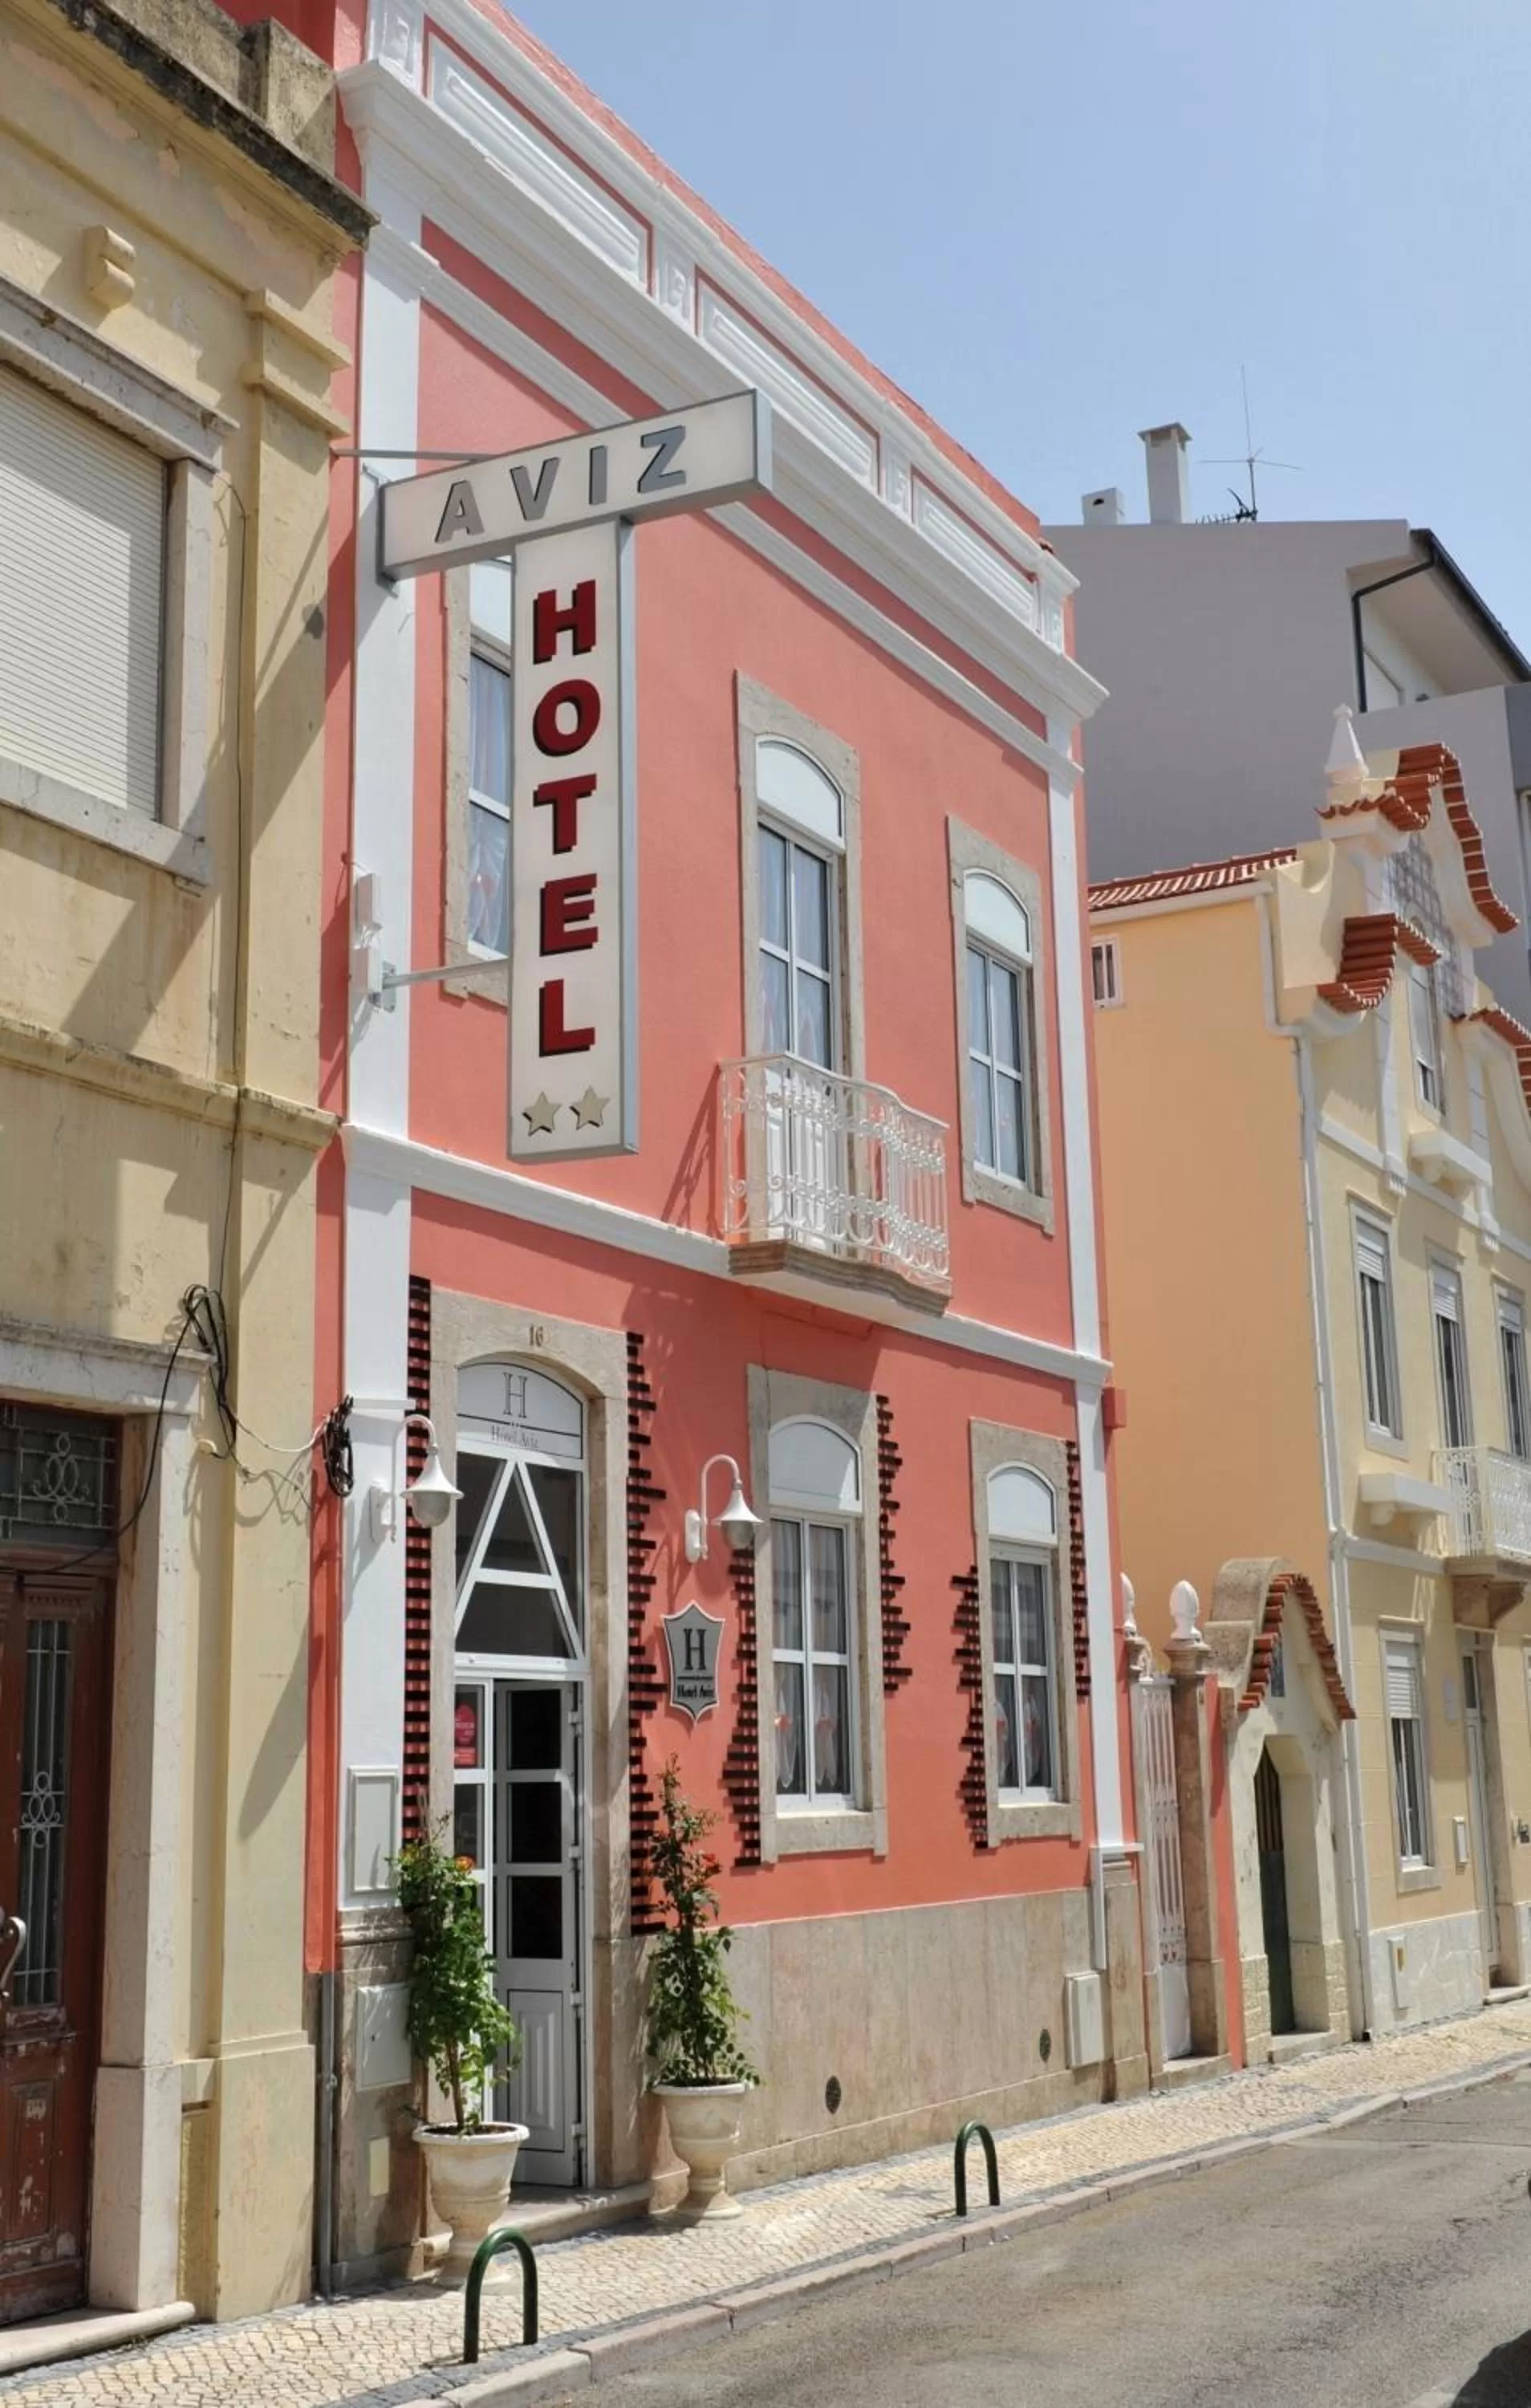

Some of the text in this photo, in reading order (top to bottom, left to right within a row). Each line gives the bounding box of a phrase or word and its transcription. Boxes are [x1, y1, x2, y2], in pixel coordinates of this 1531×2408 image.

[435, 425, 687, 543] AVIZ
[532, 579, 601, 1057] HOTEL
[529, 1325, 544, 1347] 16
[502, 1372, 528, 1419] H
[683, 1628, 707, 1670] H
